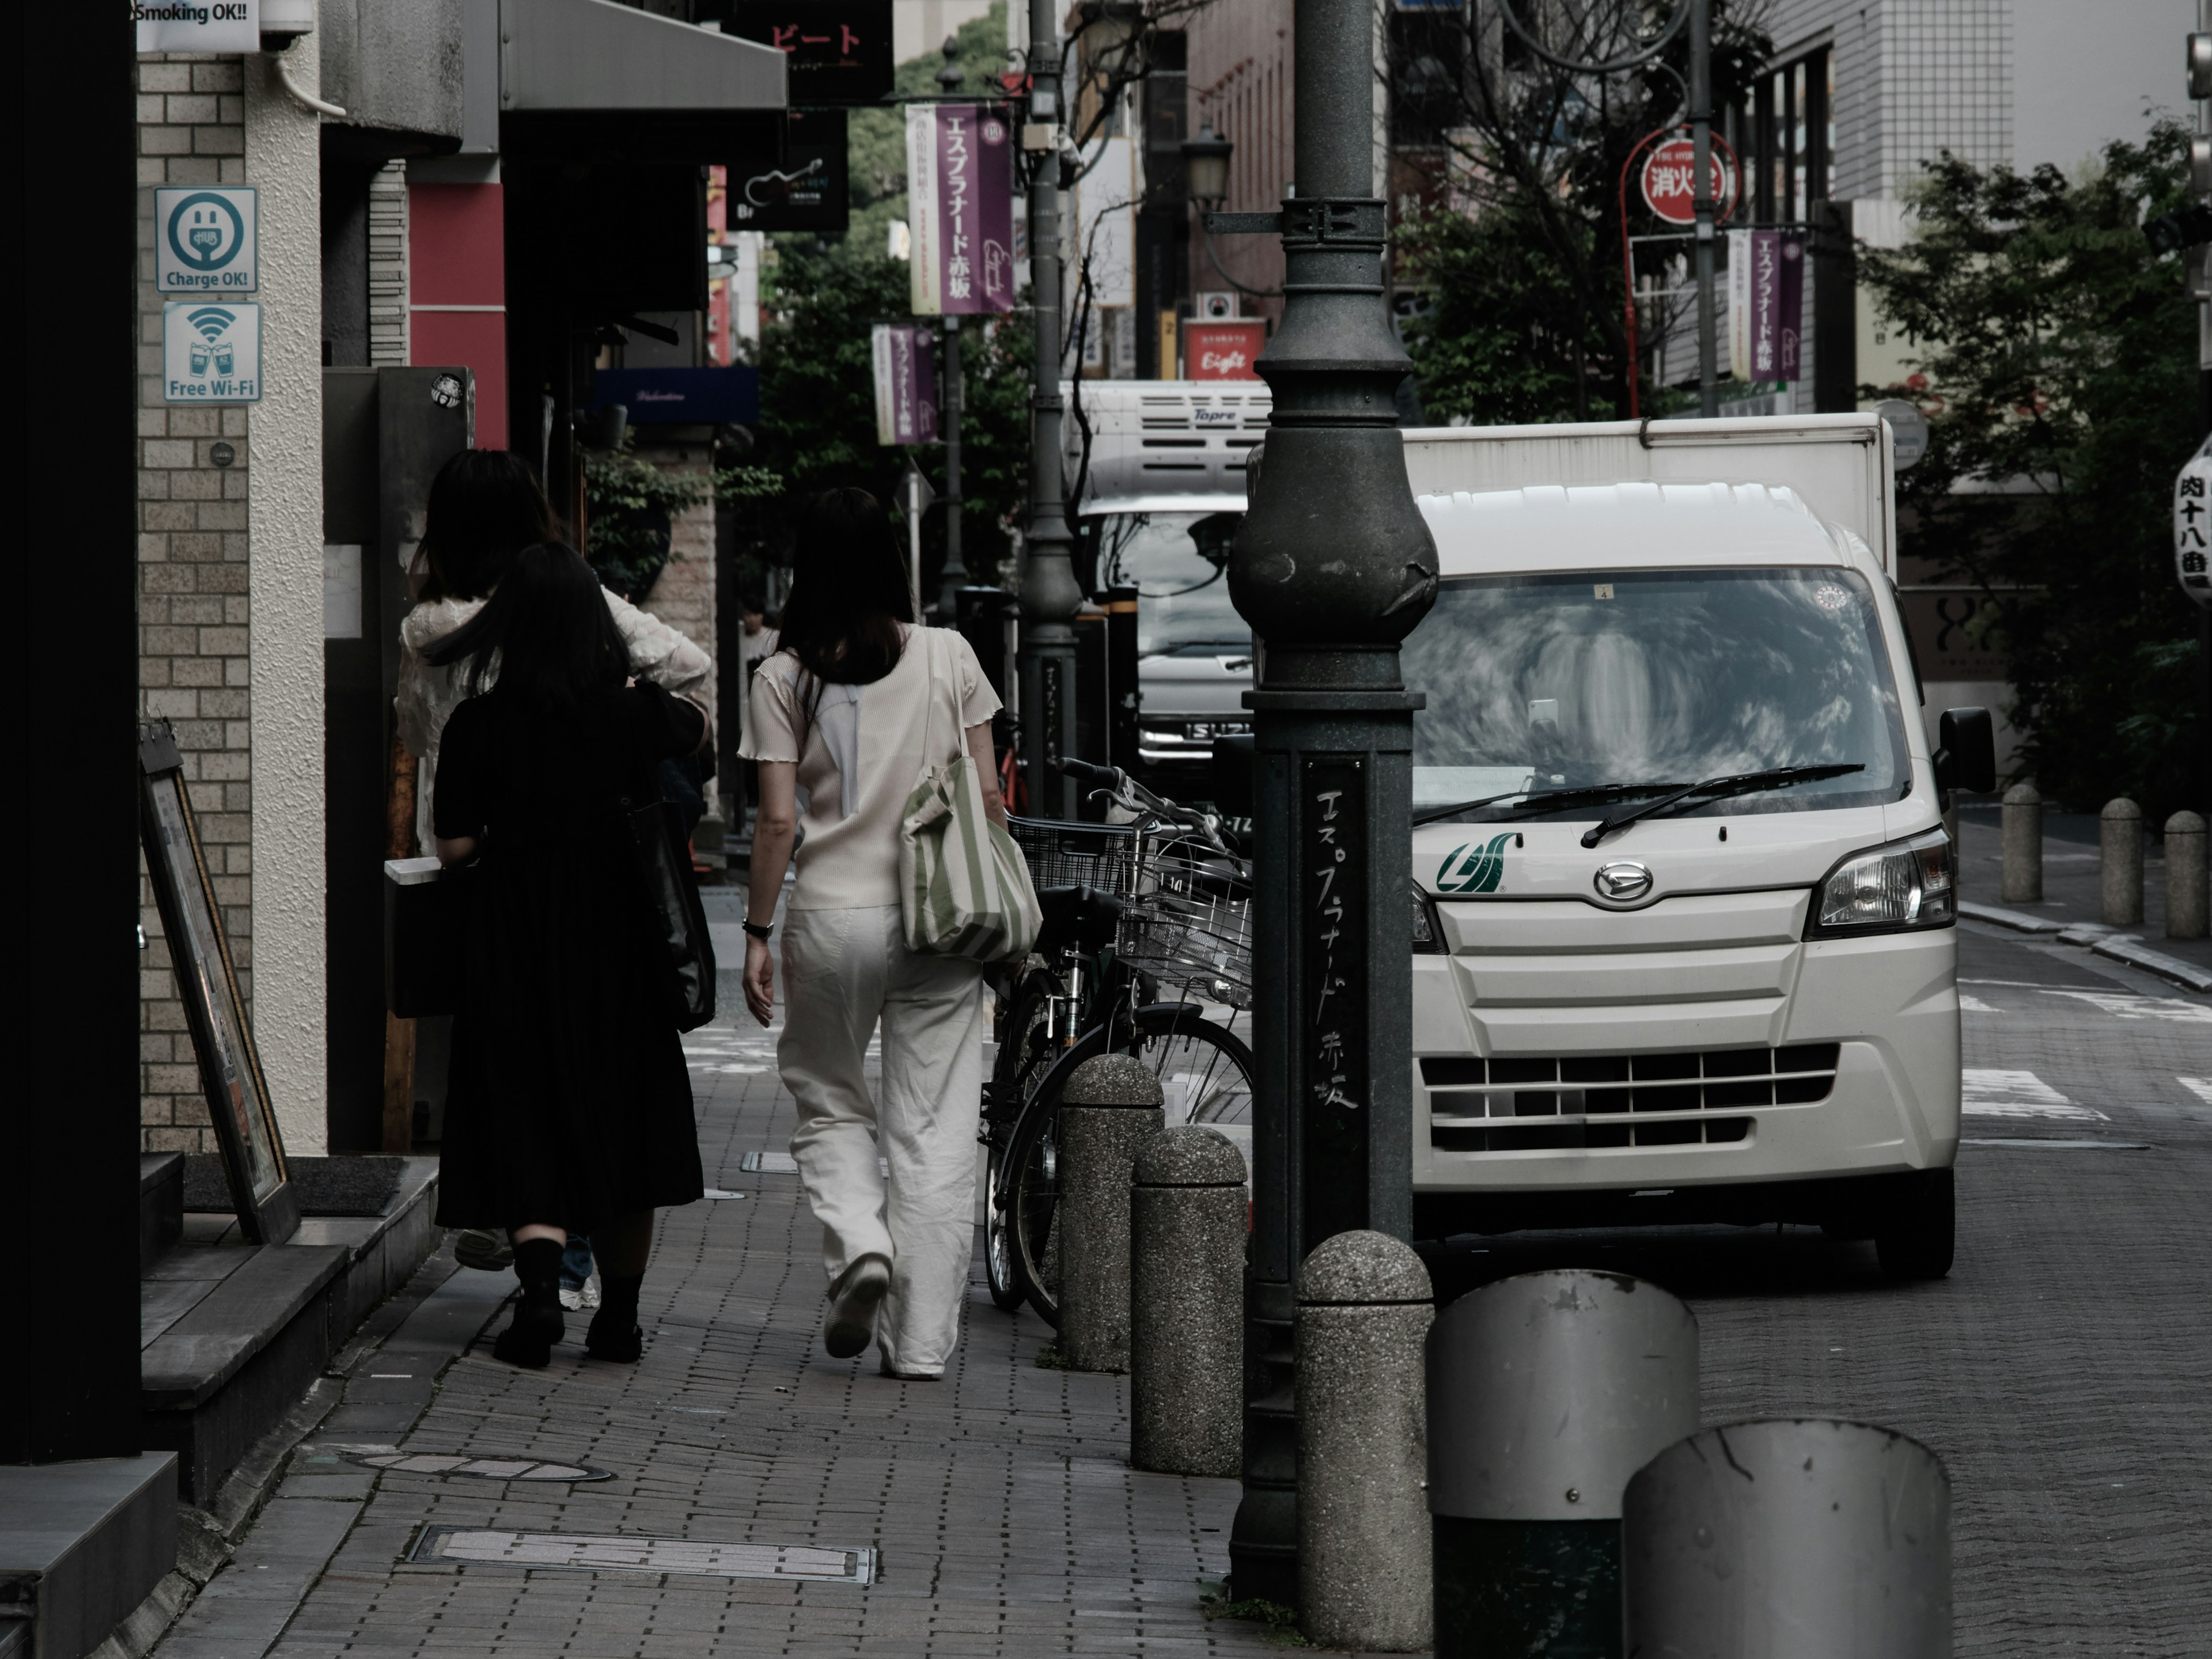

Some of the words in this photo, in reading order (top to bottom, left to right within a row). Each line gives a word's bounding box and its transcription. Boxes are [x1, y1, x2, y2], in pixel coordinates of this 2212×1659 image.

[136, 3, 208, 25] Smoking
[212, 3, 247, 20] OK!!
[771, 23, 860, 55] ビート
[946, 116, 972, 300] エスプラナード赤坂
[194, 231, 218, 246] HUB
[166, 271, 219, 289] Charge
[222, 272, 248, 286] OK!
[1756, 239, 1775, 372] エスプラナード赤坂
[169, 380, 206, 396] Free
[211, 380, 254, 396] Wi-Fi
[1194, 408, 1236, 422] Topre
